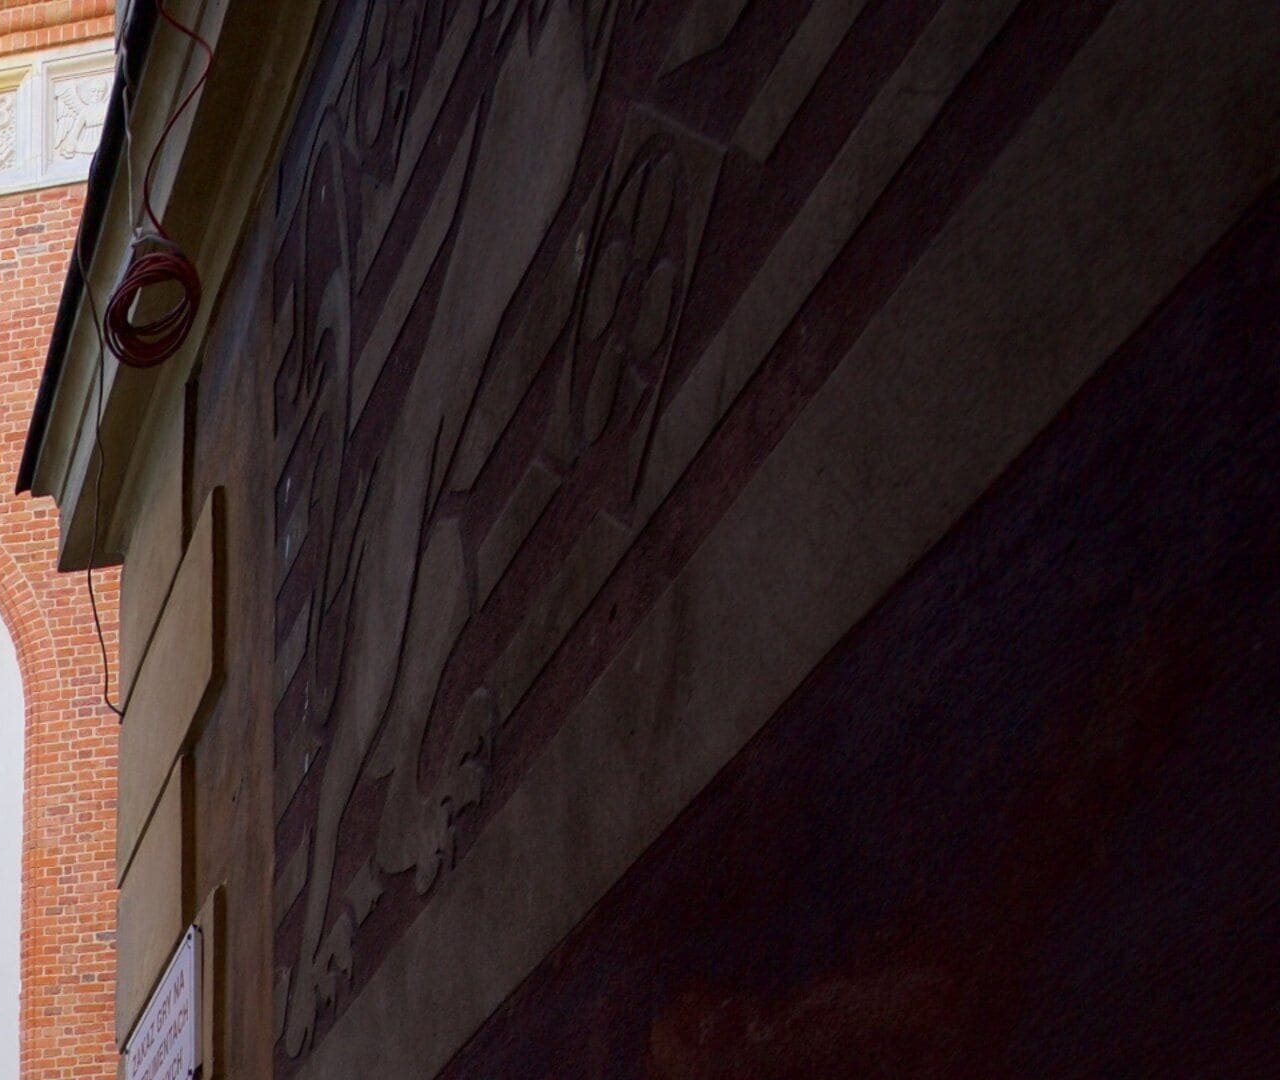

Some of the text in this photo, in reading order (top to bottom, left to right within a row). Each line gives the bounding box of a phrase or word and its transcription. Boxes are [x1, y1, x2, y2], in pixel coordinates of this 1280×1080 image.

[132, 970, 185, 1077] ZAKAZ GRY NA
